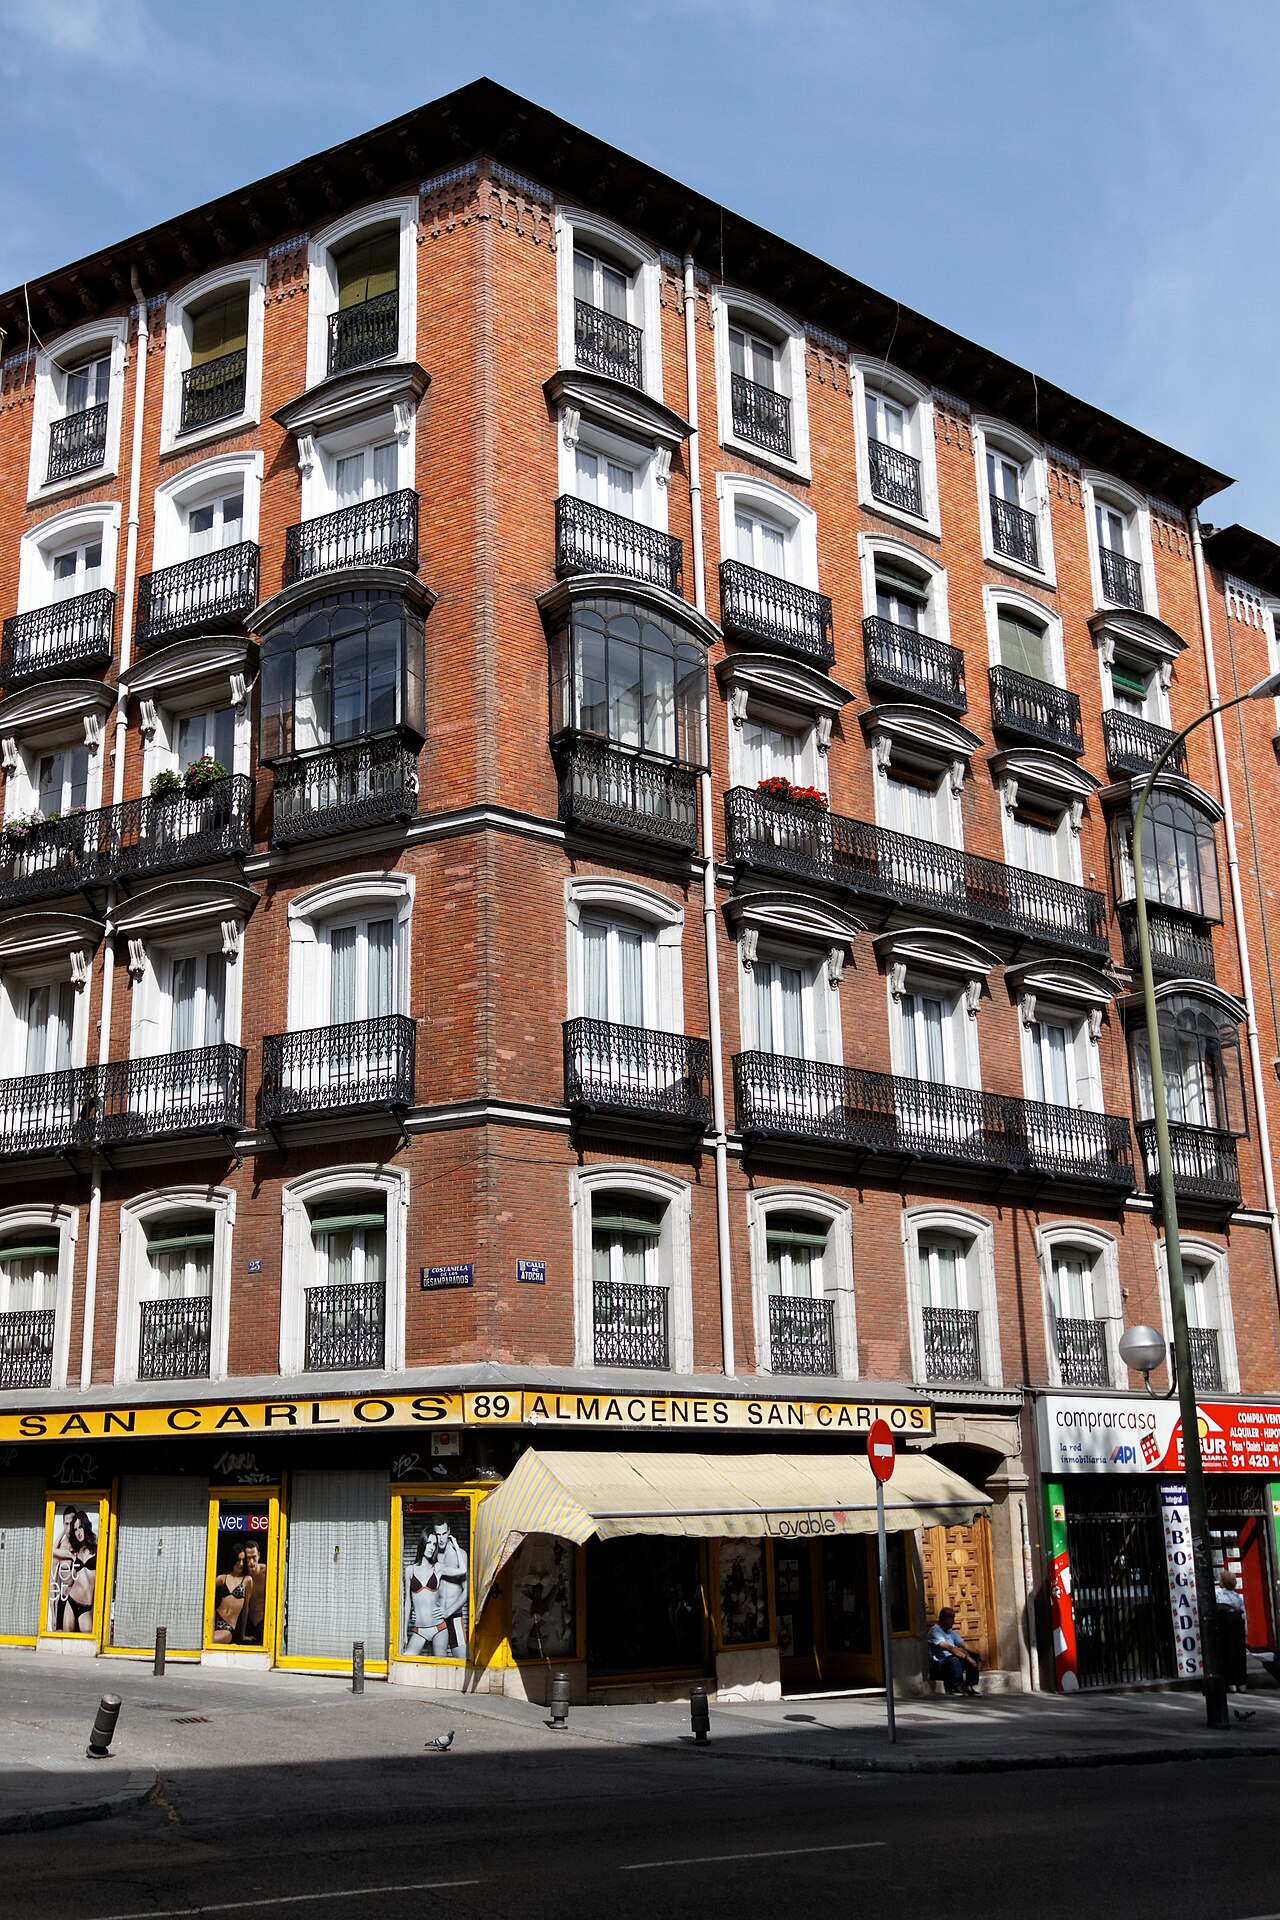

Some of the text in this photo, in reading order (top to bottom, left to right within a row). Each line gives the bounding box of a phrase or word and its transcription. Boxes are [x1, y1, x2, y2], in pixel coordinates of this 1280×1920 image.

[431, 1264, 468, 1273] COSTANILLA
[423, 1274, 469, 1287] DESAMPARADOS
[521, 1271, 544, 1281] ATOCHA
[473, 1395, 510, 1418] 89
[531, 1396, 729, 1424] ALMACENES
[748, 1402, 804, 1425] SAN
[19, 1396, 448, 1437] SAN CARLOS
[1056, 1411, 1157, 1433] comprarcasa
[1237, 1412, 1264, 1424] COMPRA
[1230, 1427, 1259, 1438] ALQUILER
[1069, 1443, 1082, 1451] red
[1060, 1455, 1107, 1464] inmobiliaria
[1112, 1446, 1137, 1464] API
[1231, 1454, 1245, 1467] 91
[1248, 1454, 1269, 1467] 420
[1272, 1454, 1280, 1468] 1
[765, 1511, 836, 1536] Lovable
[1170, 1509, 1197, 1673] ABOGADOS
